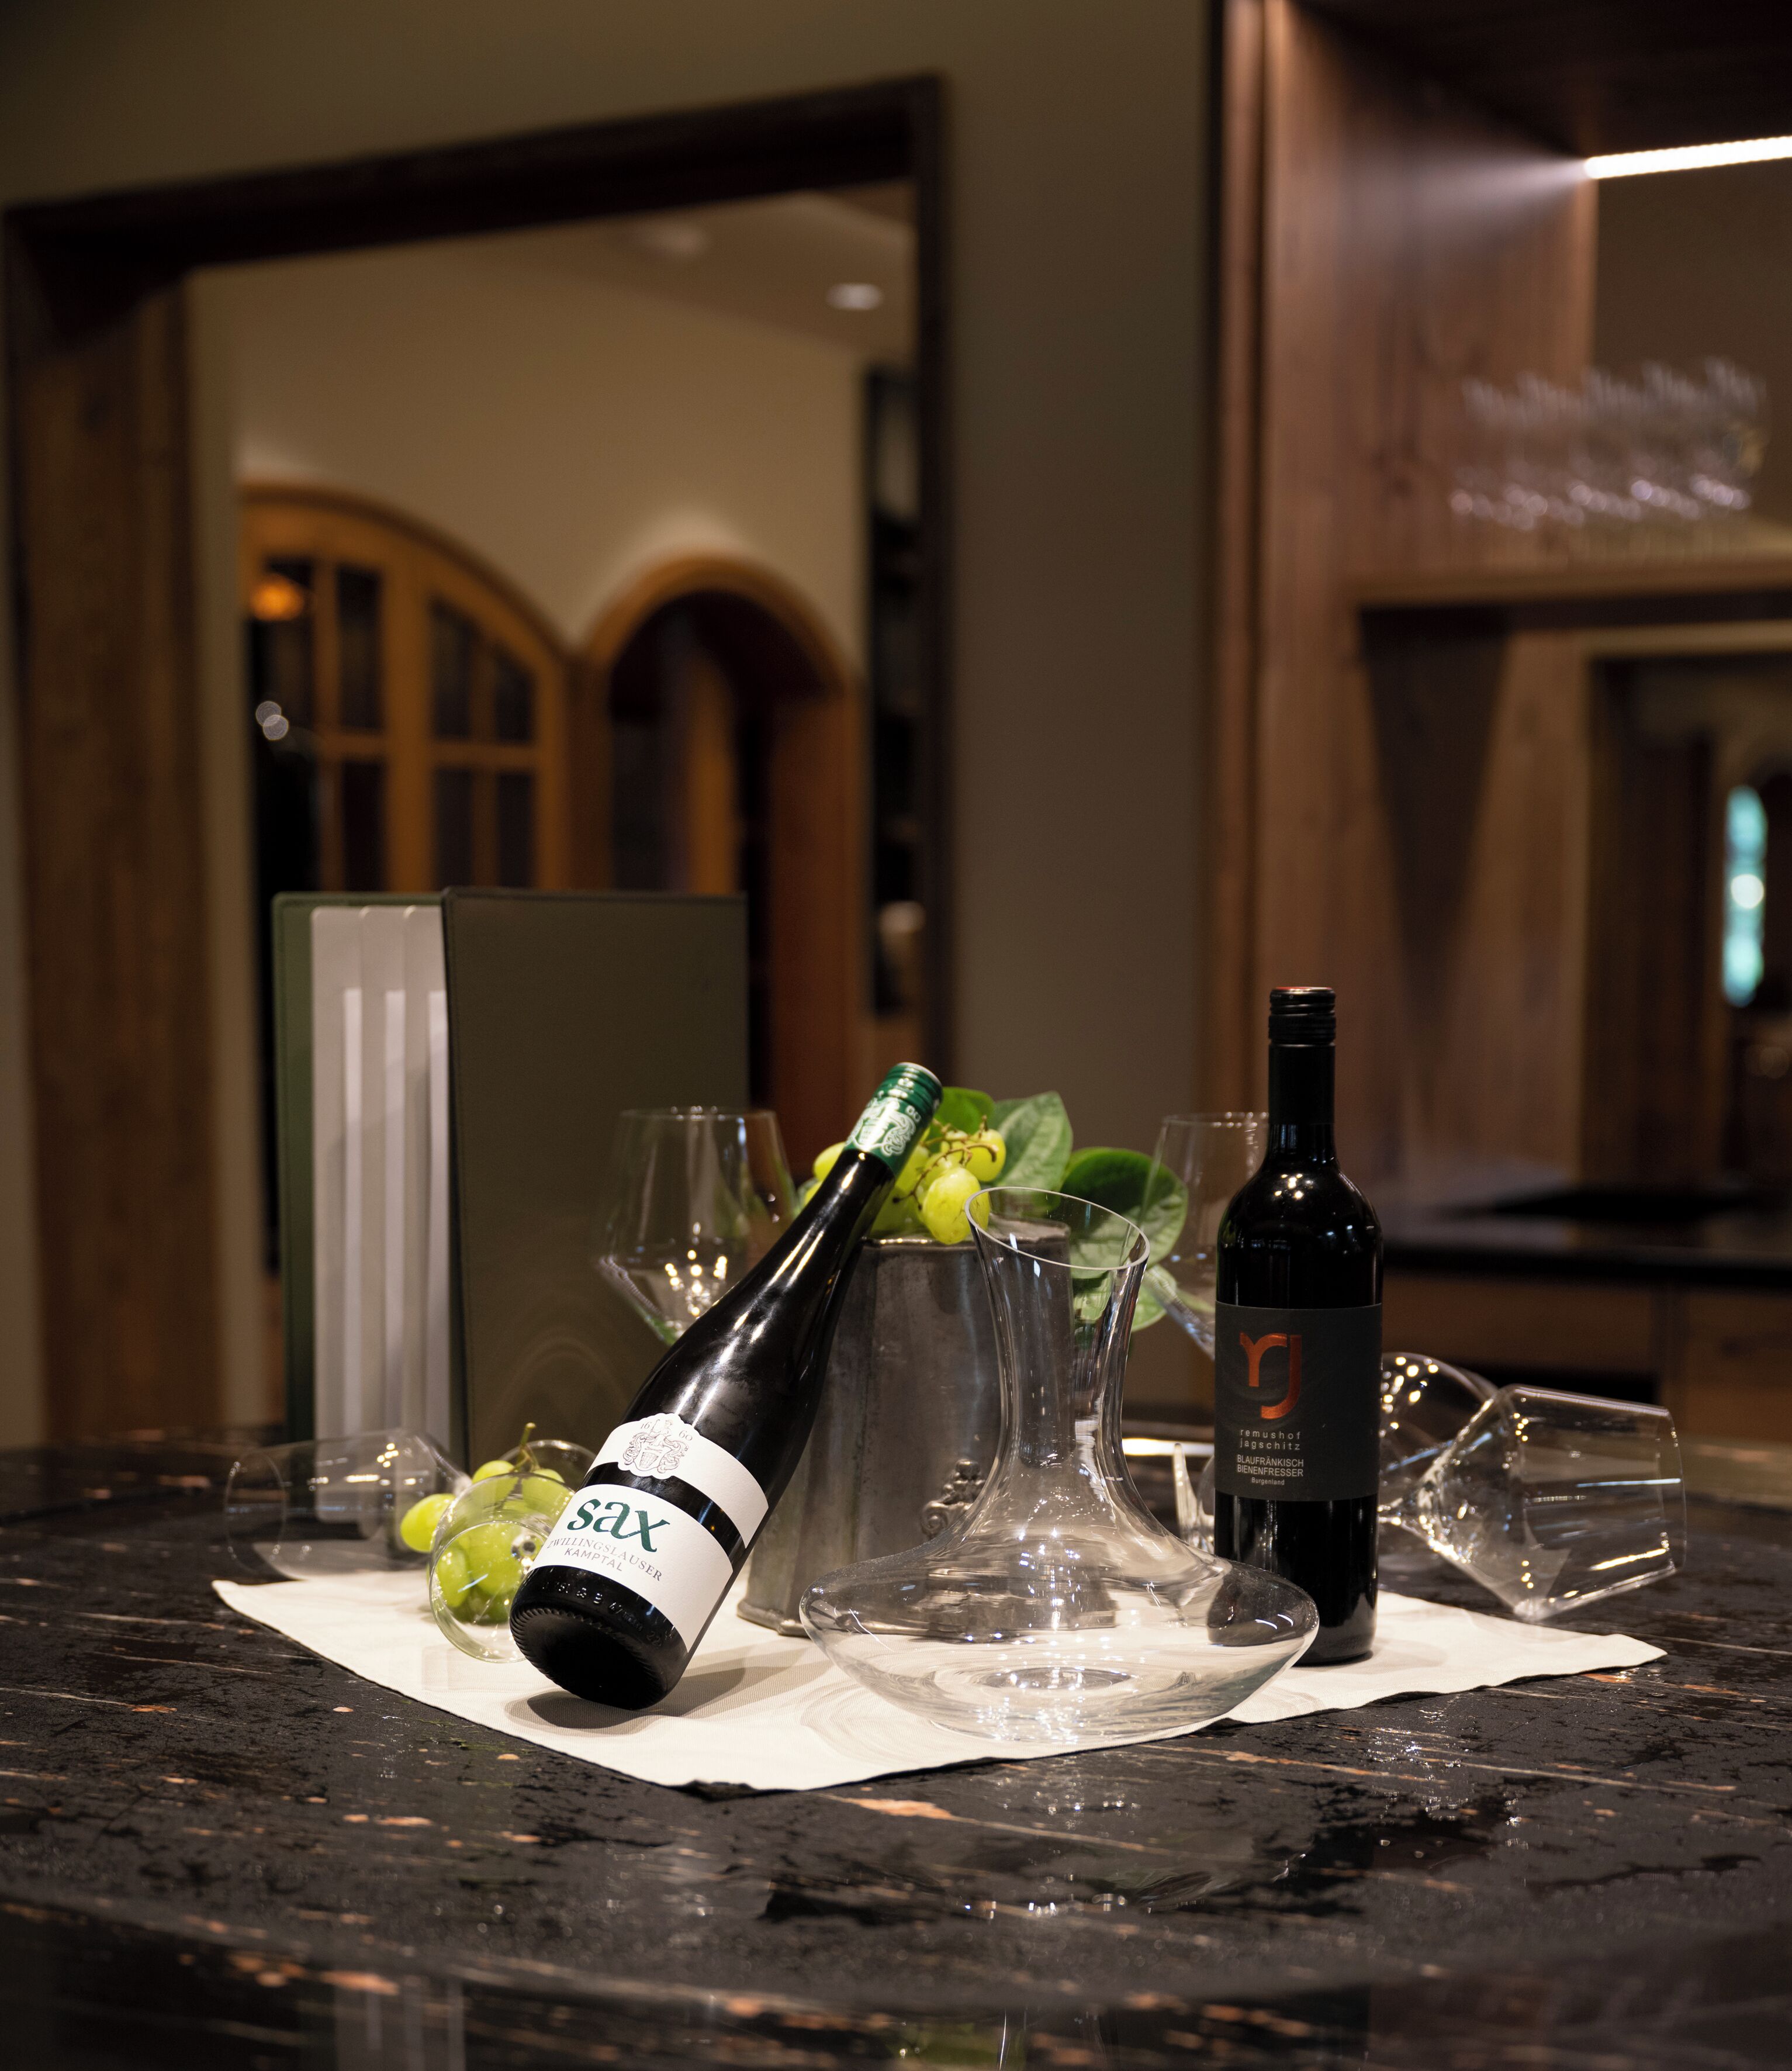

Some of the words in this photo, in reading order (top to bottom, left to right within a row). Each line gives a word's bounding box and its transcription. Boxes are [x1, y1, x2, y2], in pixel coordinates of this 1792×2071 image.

[679, 1430, 693, 1441] 60
[1240, 1429, 1300, 1440] remushof
[1240, 1438, 1300, 1450] jagschitz
[1237, 1454, 1304, 1467] BLAUFRÄNKISCH
[1237, 1464, 1304, 1477] BIENENFRESSER
[1251, 1477, 1285, 1485] Burgenland
[567, 1499, 670, 1553] sax
[547, 1537, 662, 1581] ZWILLINGSLAUSER
[565, 1548, 622, 1572] KAMPTAL
